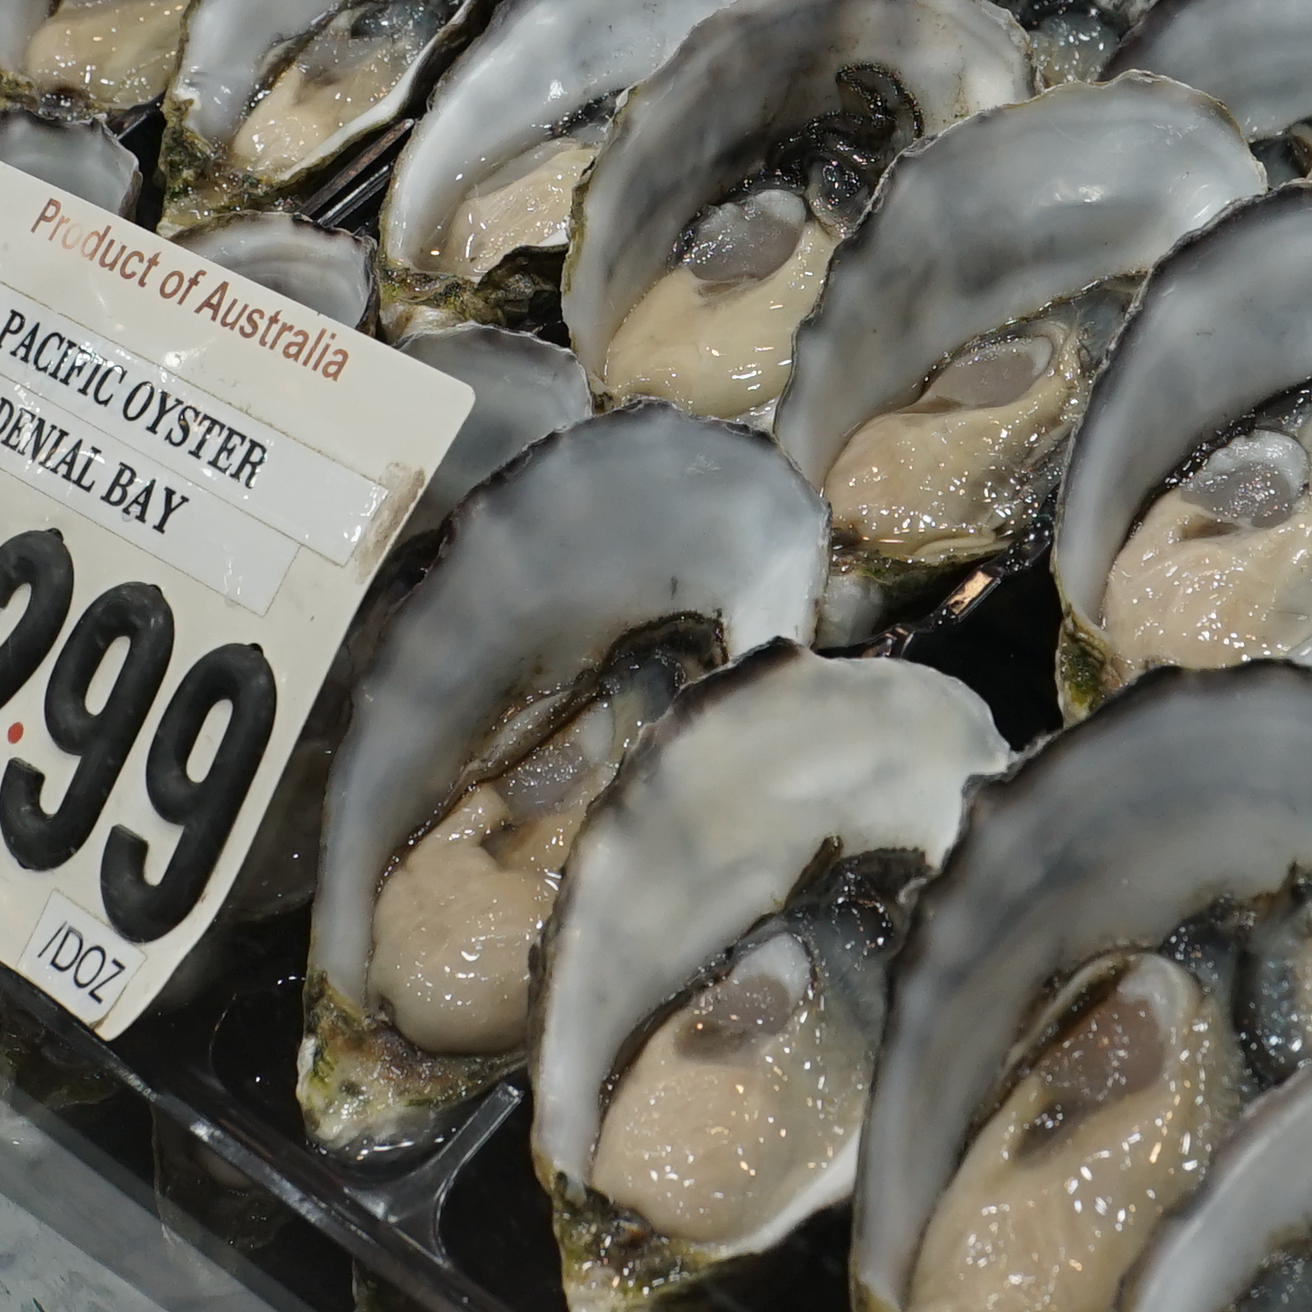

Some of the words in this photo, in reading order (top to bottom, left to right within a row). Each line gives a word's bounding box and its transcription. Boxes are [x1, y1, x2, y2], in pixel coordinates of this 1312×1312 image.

[30, 198, 161, 288] Product
[159, 269, 207, 306] of
[194, 281, 350, 382] Australia
[122, 381, 268, 489] OYSTER
[100, 462, 190, 534] BAY
[37, 920, 126, 1005] /DOZ
